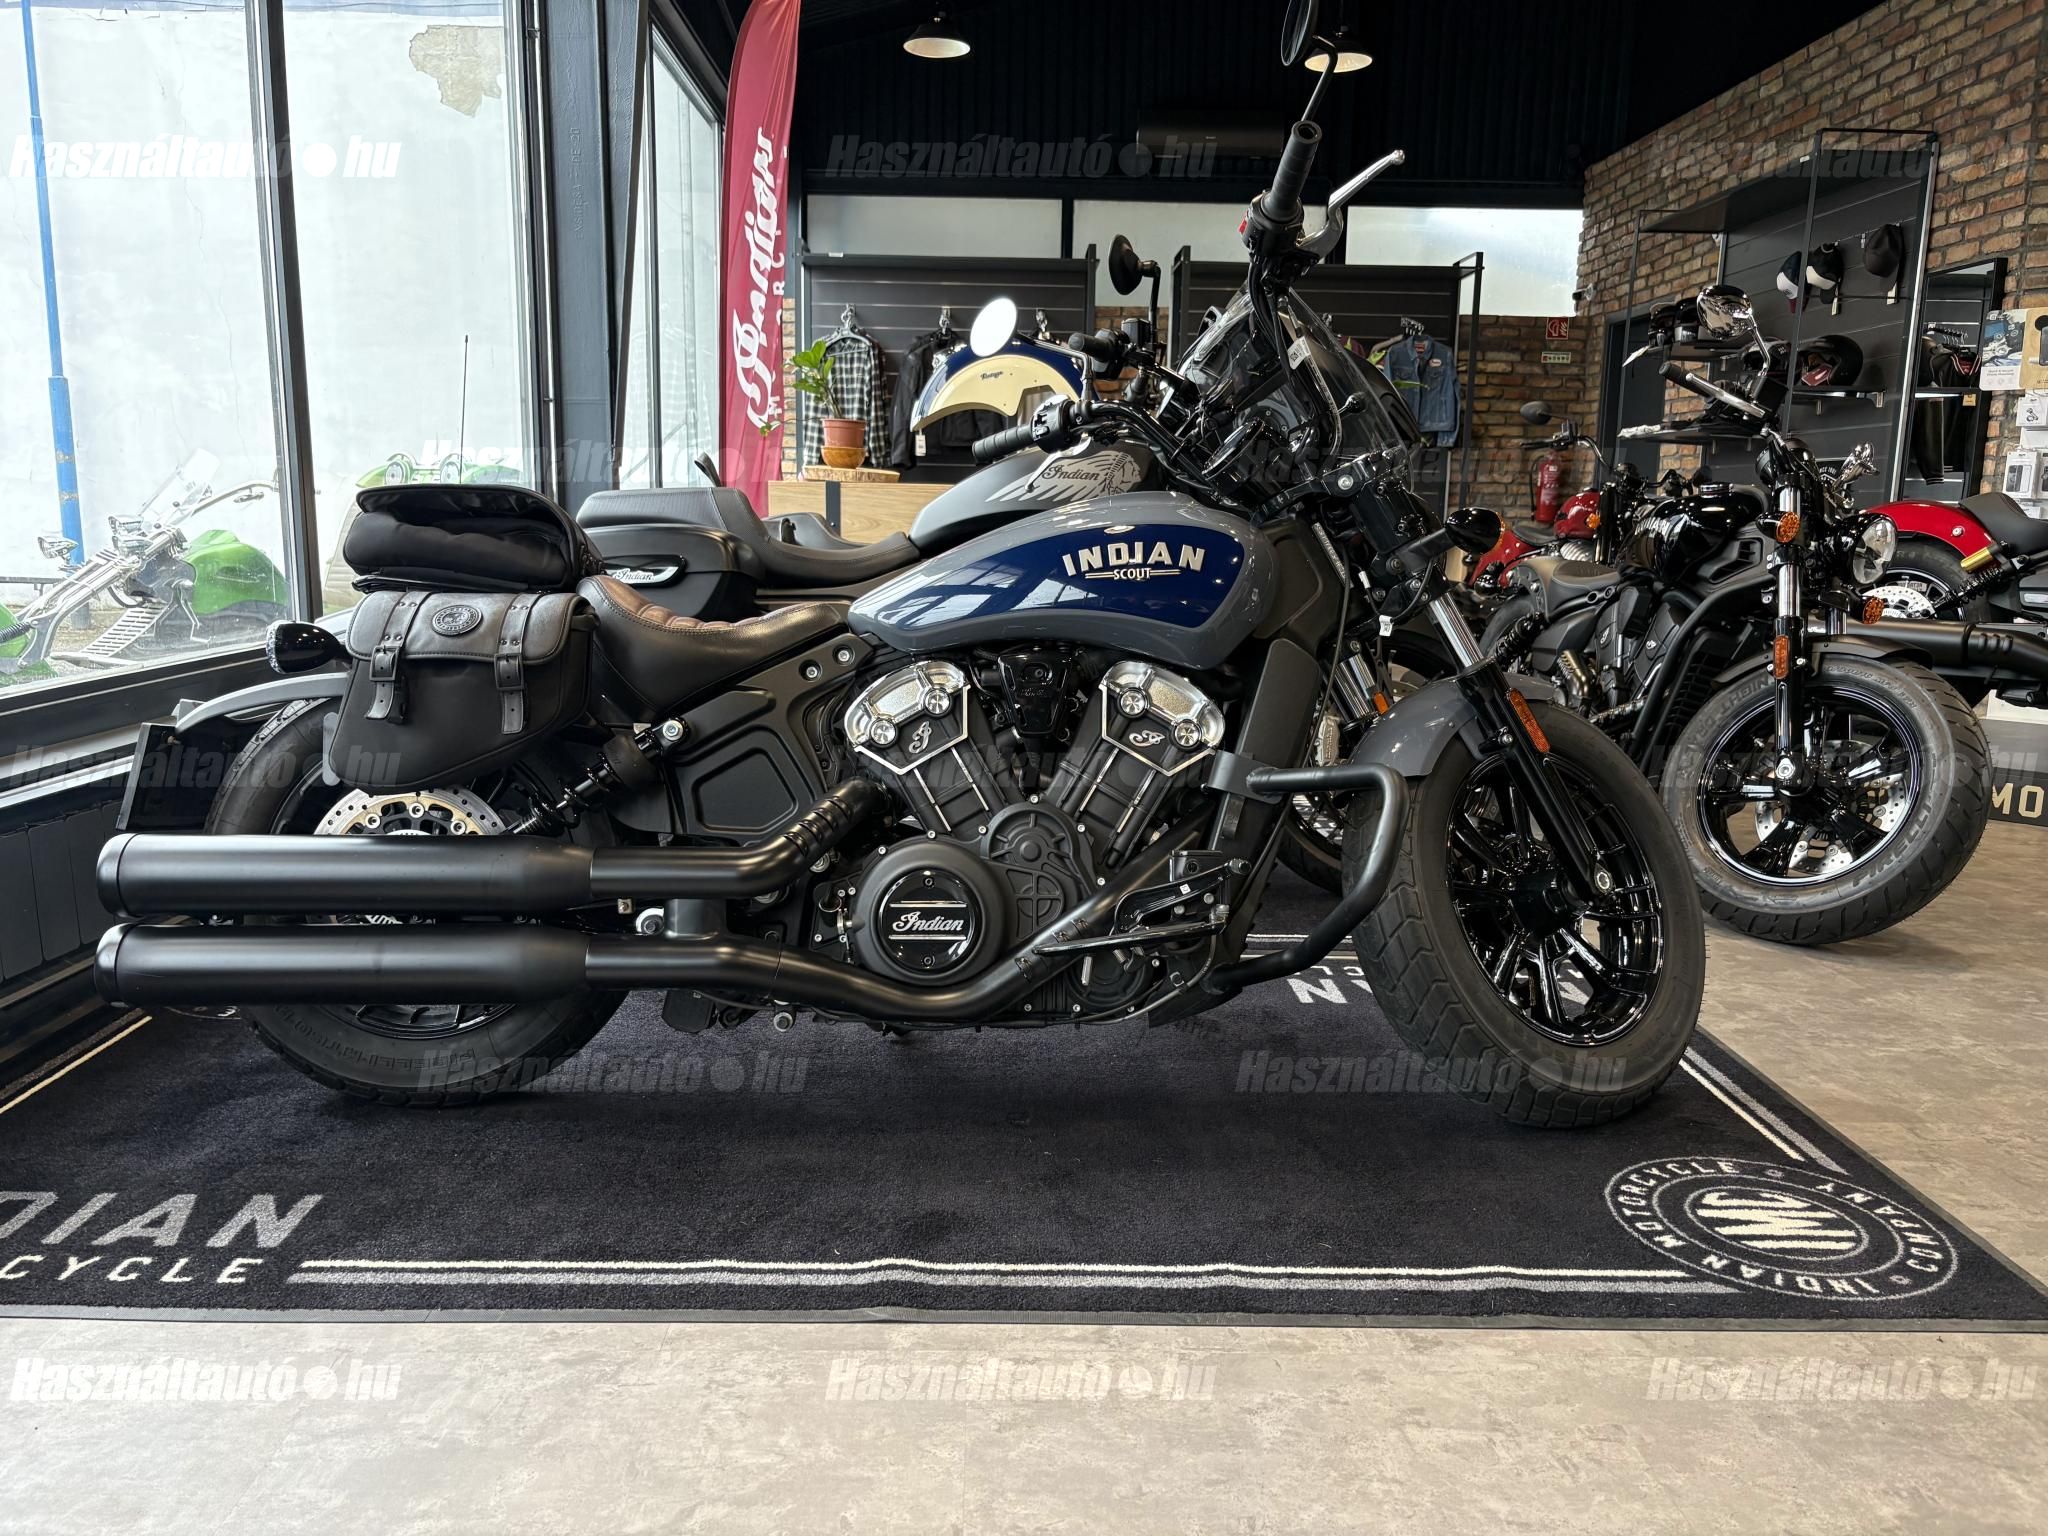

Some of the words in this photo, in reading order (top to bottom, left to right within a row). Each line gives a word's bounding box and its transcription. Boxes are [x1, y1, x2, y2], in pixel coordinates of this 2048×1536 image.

[733, 126, 778, 428] Indian
[1041, 464, 1101, 481] Indian
[611, 568, 655, 582] Indian
[1062, 541, 1206, 577] INDIAN
[1113, 567, 1152, 581] SCOUT
[892, 910, 964, 932] Indian
[1617, 1161, 1741, 1249] MOTORCYCLE
[1815, 1183, 1944, 1273] COMPANY
[1703, 1253, 1880, 1295] INDIAN
